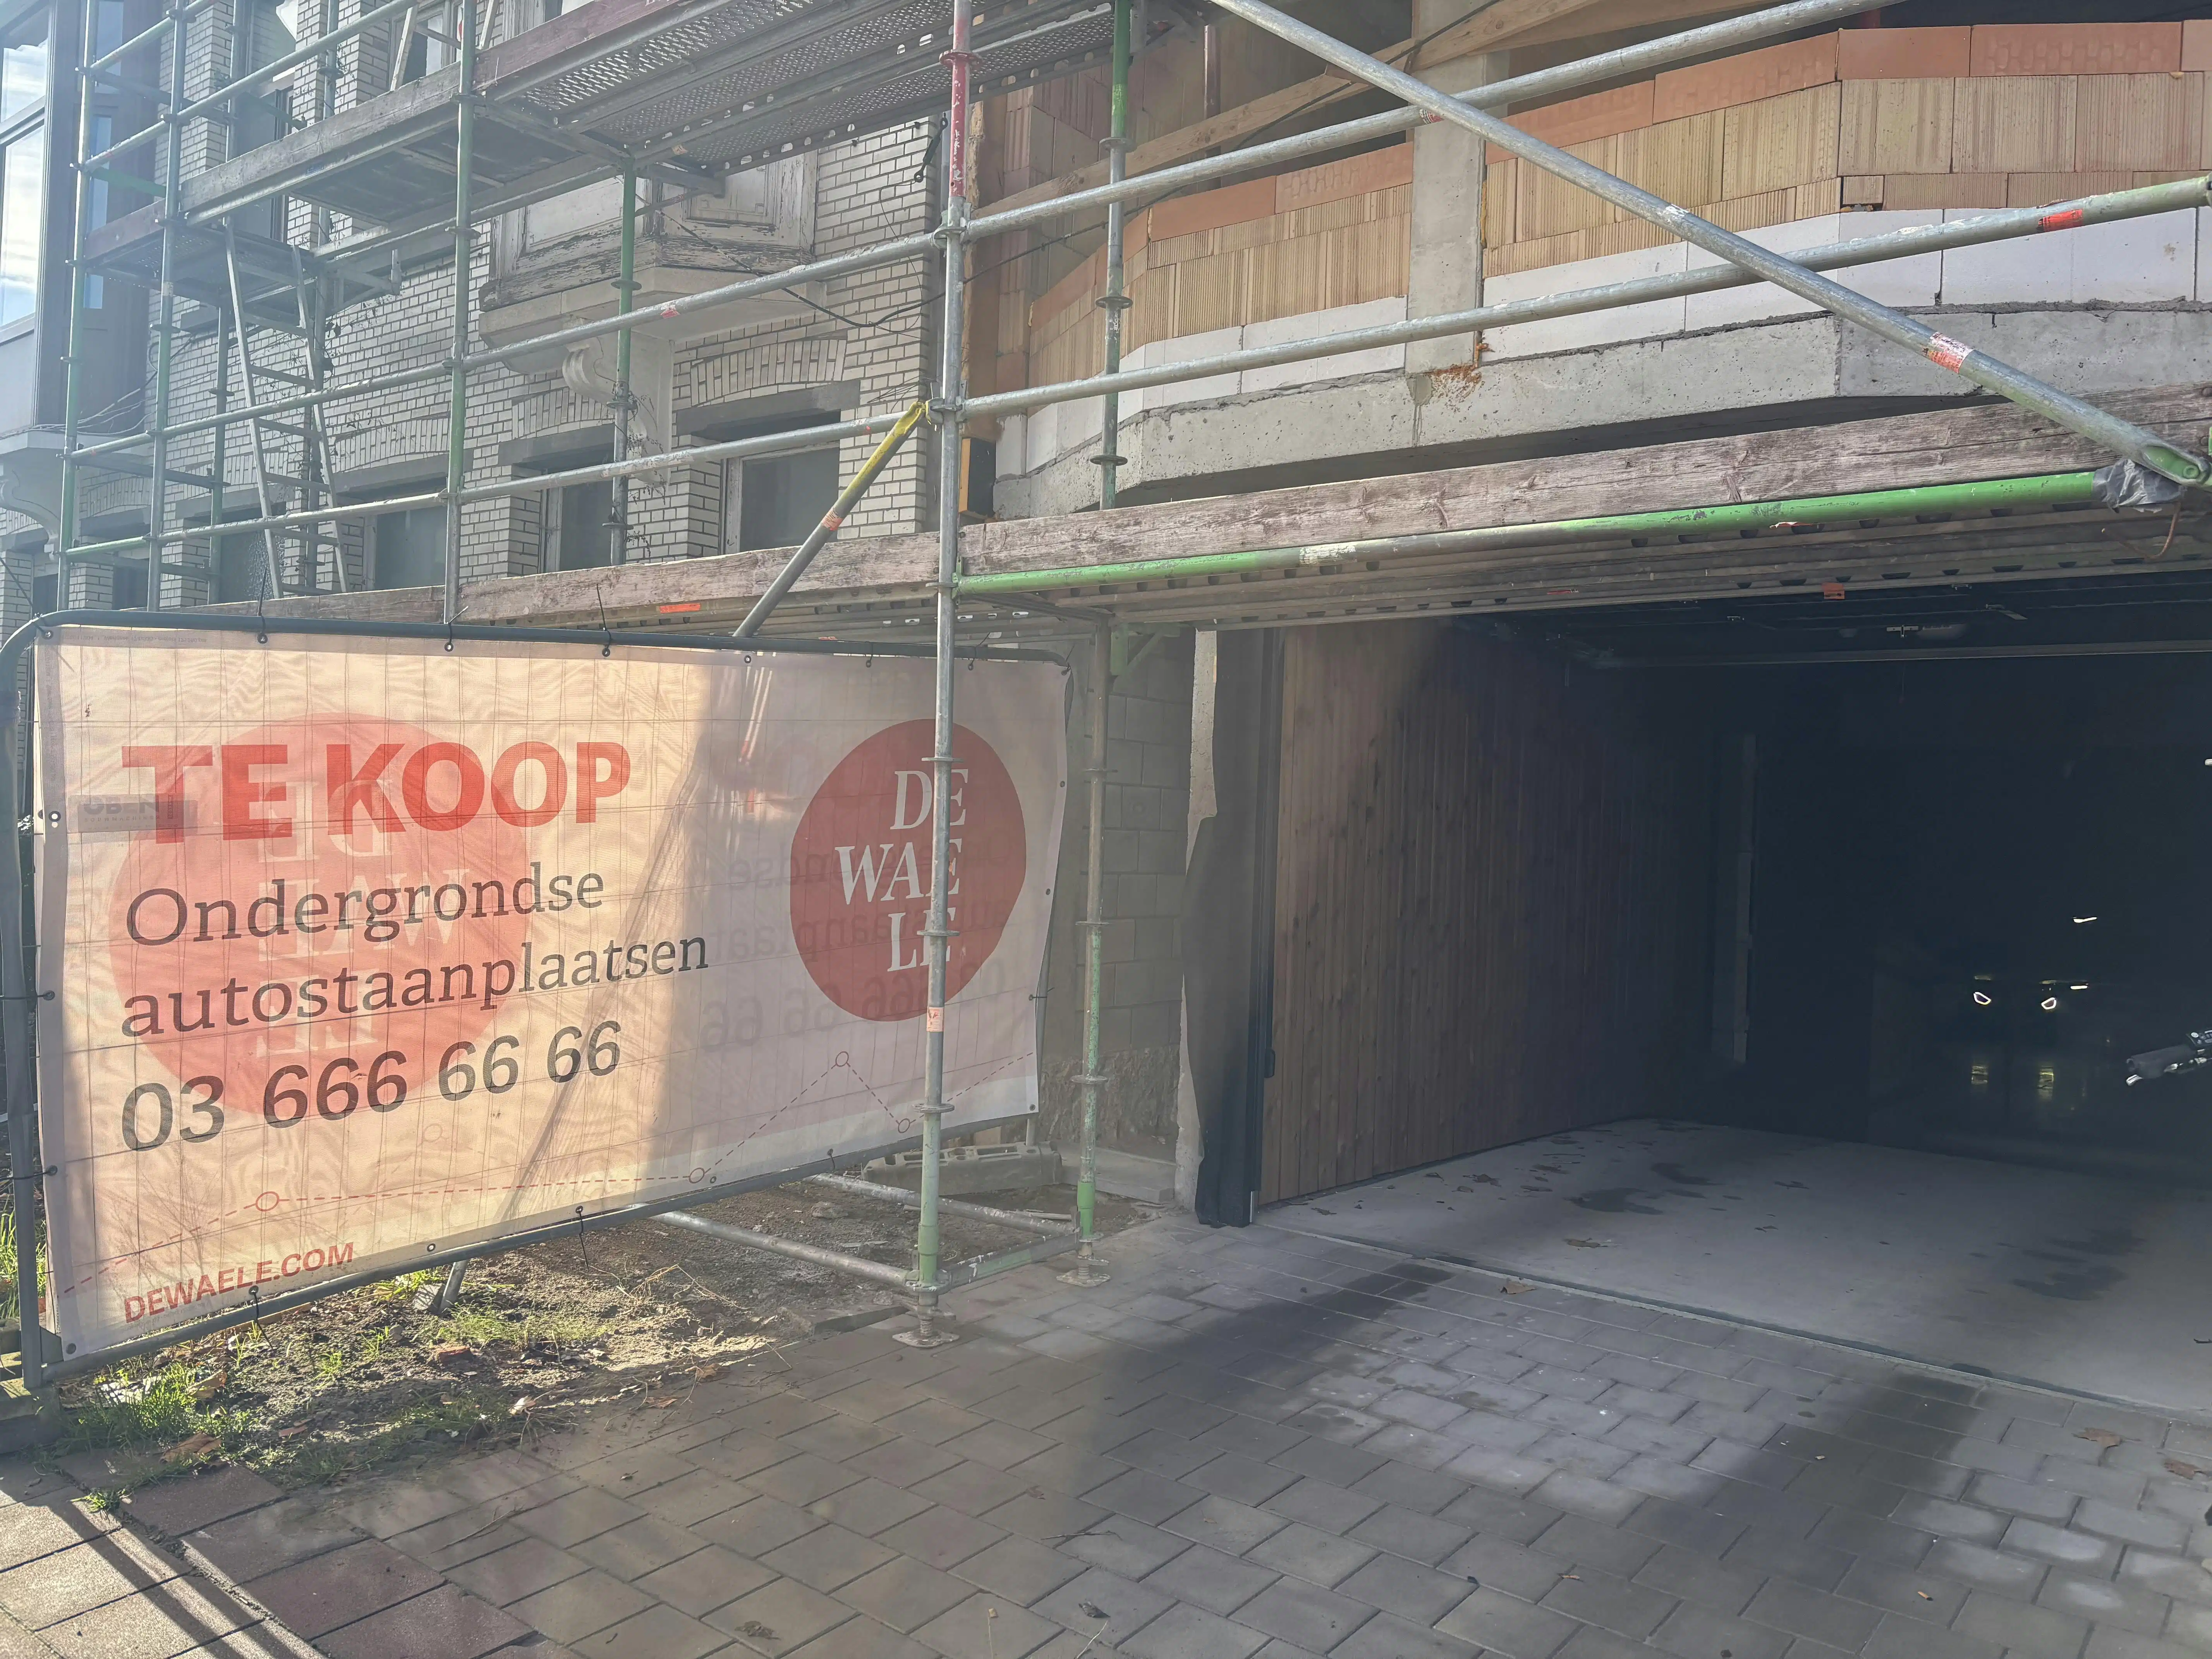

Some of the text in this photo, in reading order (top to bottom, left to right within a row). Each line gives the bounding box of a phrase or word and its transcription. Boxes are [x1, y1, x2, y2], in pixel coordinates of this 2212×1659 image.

[122, 741, 630, 844] TE KOOP
[126, 861, 604, 946] Ondergrondse
[121, 935, 709, 1037] autostaanplaatsen
[122, 1020, 622, 1152] 03 666 66 66
[124, 1242, 354, 1324] DEWAELE.COM
